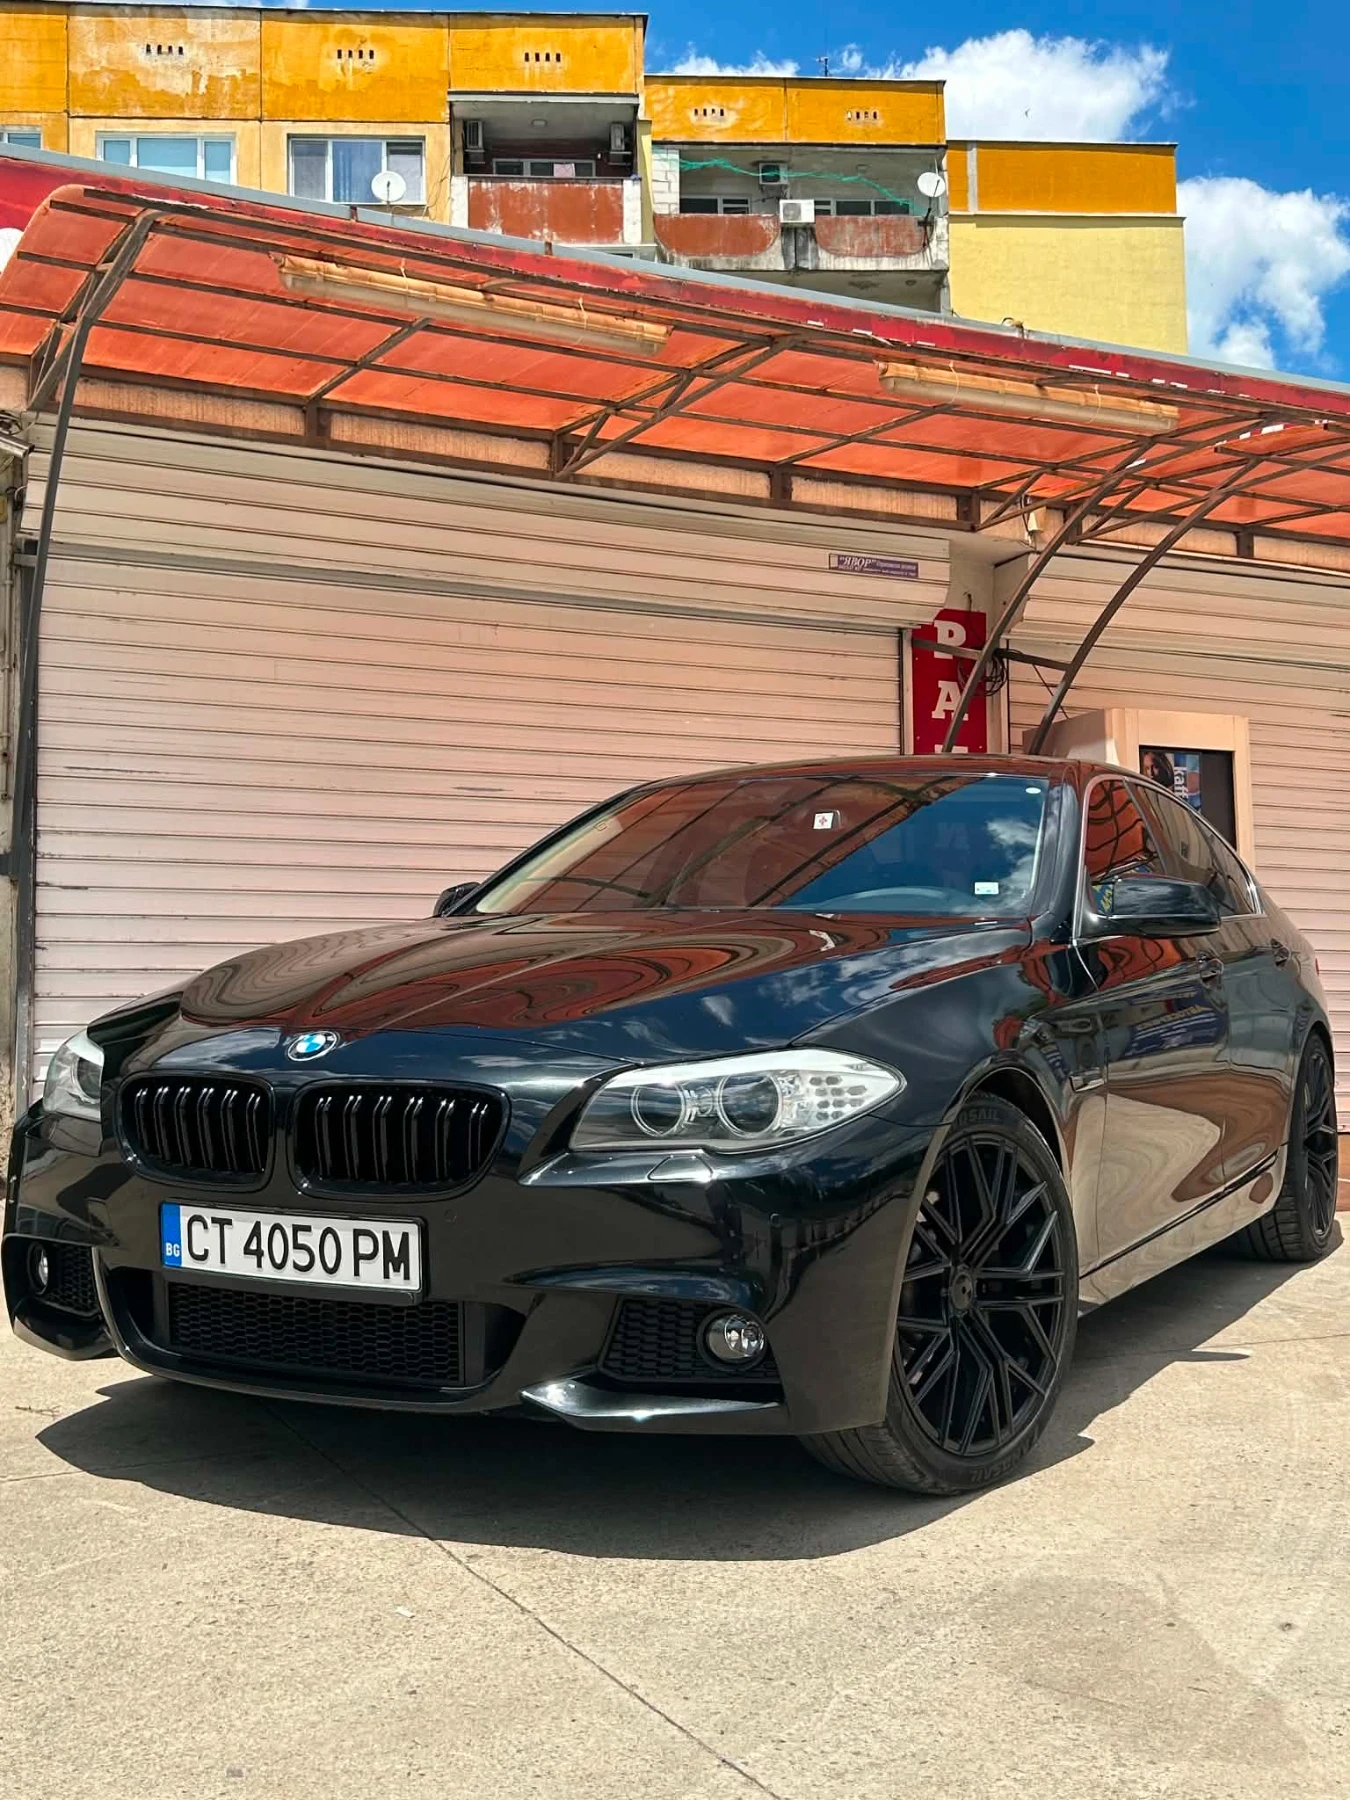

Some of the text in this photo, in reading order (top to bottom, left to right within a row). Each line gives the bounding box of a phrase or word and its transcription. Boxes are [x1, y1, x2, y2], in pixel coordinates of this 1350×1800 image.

[165, 1243, 180, 1257] BG
[187, 1214, 410, 1281] CT 4050 PM
